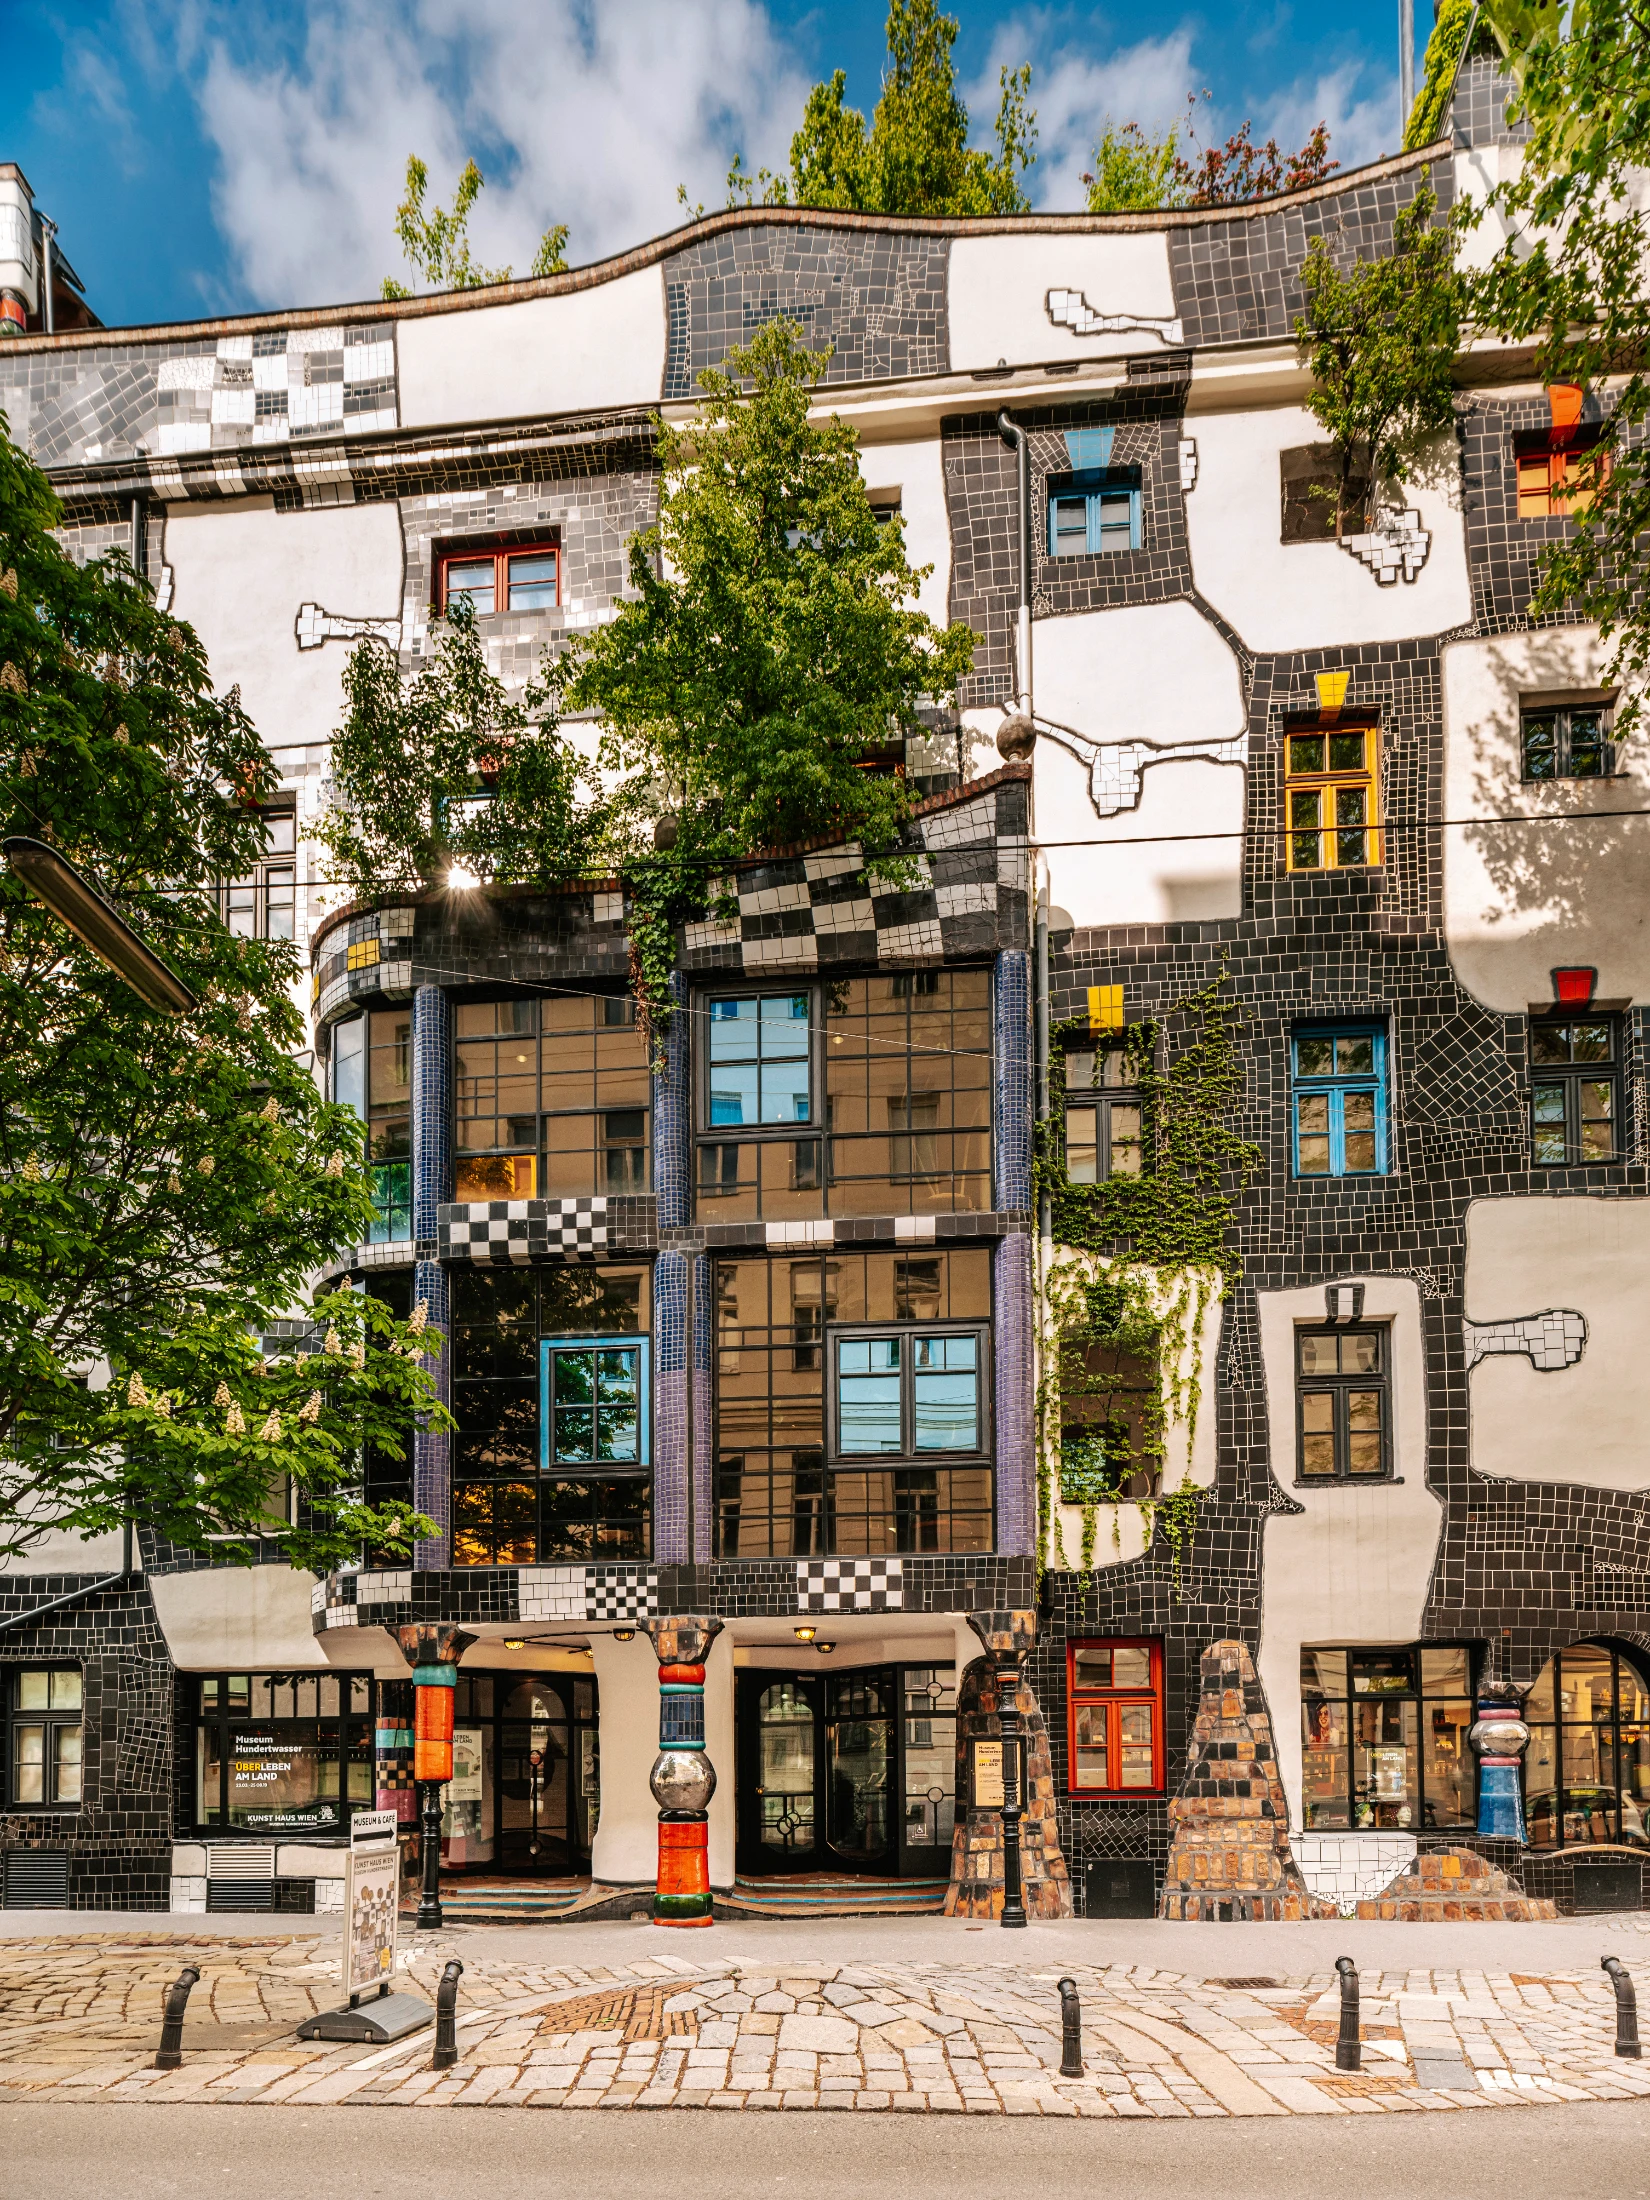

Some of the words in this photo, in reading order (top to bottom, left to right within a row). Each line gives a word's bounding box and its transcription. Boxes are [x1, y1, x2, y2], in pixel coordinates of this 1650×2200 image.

[235, 1735, 274, 1744] Museum
[235, 1744, 303, 1753] Hundertwasser
[235, 1761, 292, 1771] ÜBERLEBEN
[235, 1772, 250, 1781] AM
[251, 1772, 278, 1781] LAND
[247, 1814, 274, 1822] KUNST
[275, 1814, 296, 1822] HAUS
[297, 1814, 318, 1822] WIEN
[353, 1816, 377, 1827] MUSEUM
[378, 1816, 382, 1825] &
[382, 1812, 396, 1823] CAFÉ
[354, 1860, 370, 1869] KUNST
[370, 1858, 382, 1867] HAUS
[382, 1857, 394, 1865] WIEN
